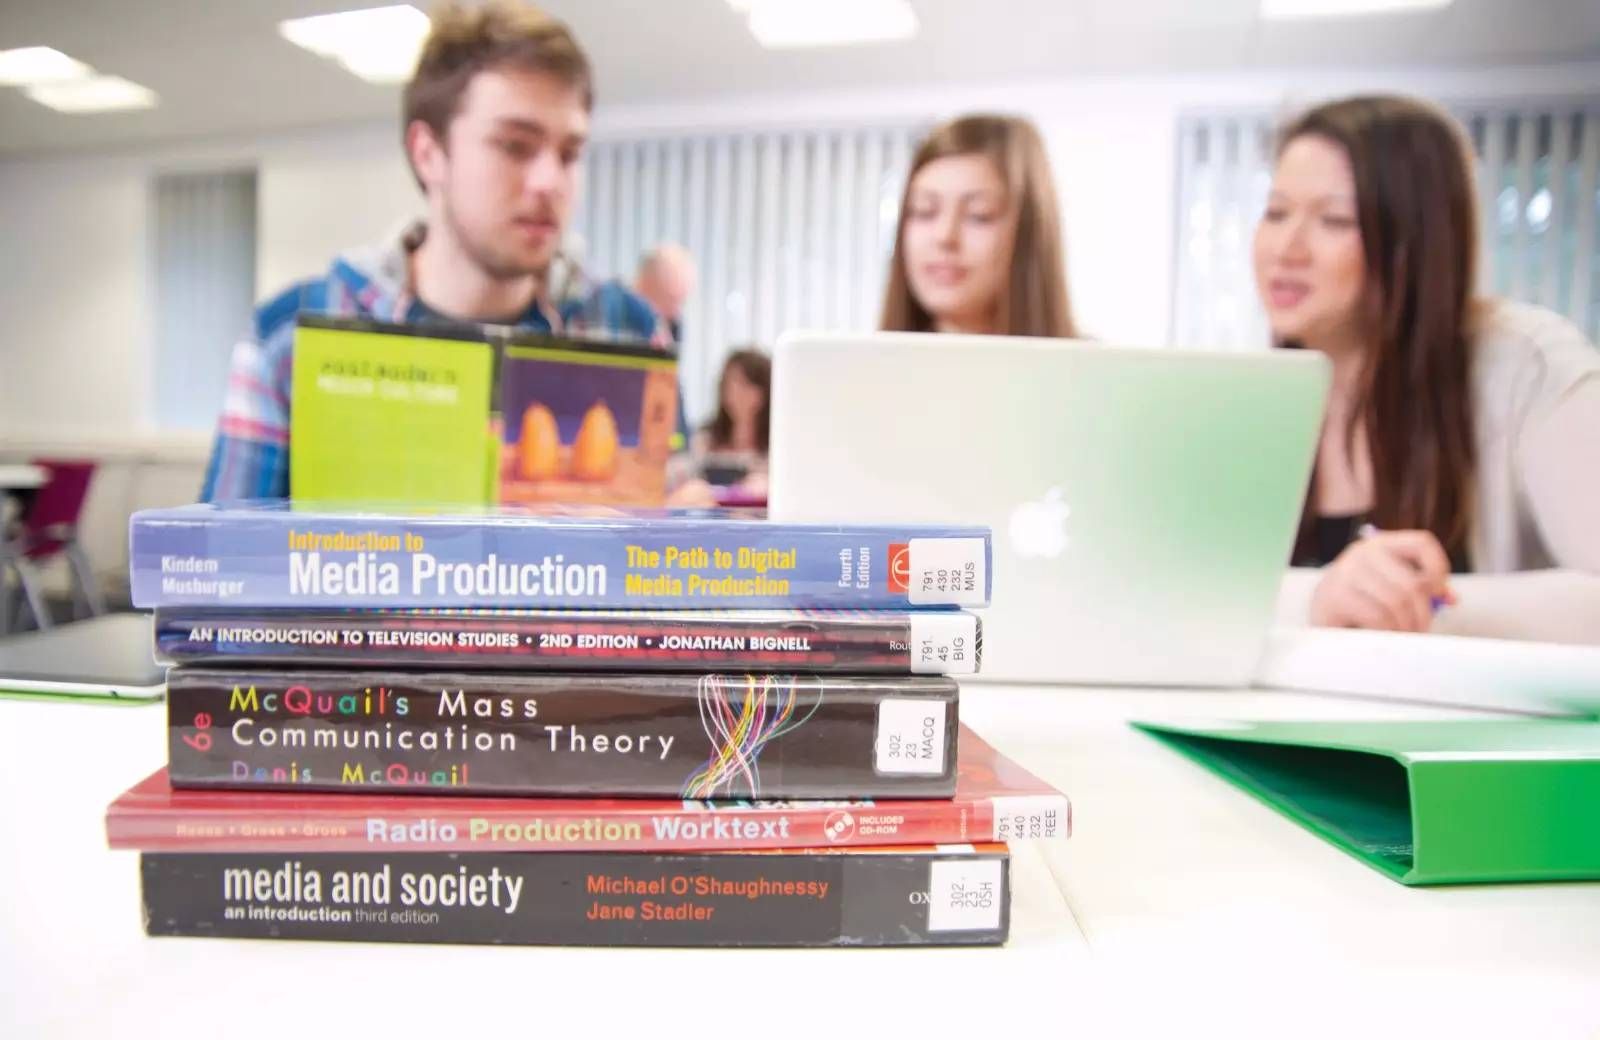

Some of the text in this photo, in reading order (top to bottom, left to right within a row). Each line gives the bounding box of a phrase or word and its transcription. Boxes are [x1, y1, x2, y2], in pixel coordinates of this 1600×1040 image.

[288, 530, 423, 552] Introduction to
[161, 556, 218, 573] Kindem
[625, 546, 796, 573] The Path to Digital
[838, 547, 852, 588] Fourth
[856, 547, 870, 589] Edition
[289, 552, 607, 597] Media Production
[626, 575, 790, 597] Media Production
[923, 570, 933, 592] 791
[937, 569, 948, 592] 430
[951, 569, 961, 592] 232
[965, 561, 975, 591] MUS
[162, 577, 244, 597] Musburger
[189, 628, 811, 652] AN INTRODUCTION TO TELEVISION STUDIES 2ND EDITION JONATHAN BIGNELL
[889, 640, 912, 651] Rout
[953, 637, 964, 661] BIG
[938, 646, 949, 662] 45
[229, 684, 538, 717] McQuail's Mass
[182, 711, 212, 752] 6e
[232, 718, 675, 759] Communication Theory
[921, 716, 936, 760] MACQ
[905, 743, 917, 760] 23
[232, 760, 469, 786] Denis McQuail
[366, 816, 789, 844] Radio Production Worktext
[859, 815, 905, 826] INCLUDES
[859, 826, 898, 836] CD-ROM
[1014, 815, 1025, 840] 440
[1030, 815, 1040, 839] 232
[1045, 809, 1056, 838] REE
[223, 861, 524, 914] media and society
[587, 875, 829, 899] Michael O'Shaughnessy
[909, 891, 931, 905] OX
[979, 881, 993, 909] OSH
[587, 902, 714, 921] Jane Stadler
[965, 891, 978, 908] 23
[224, 905, 439, 924] an introduction third edition
